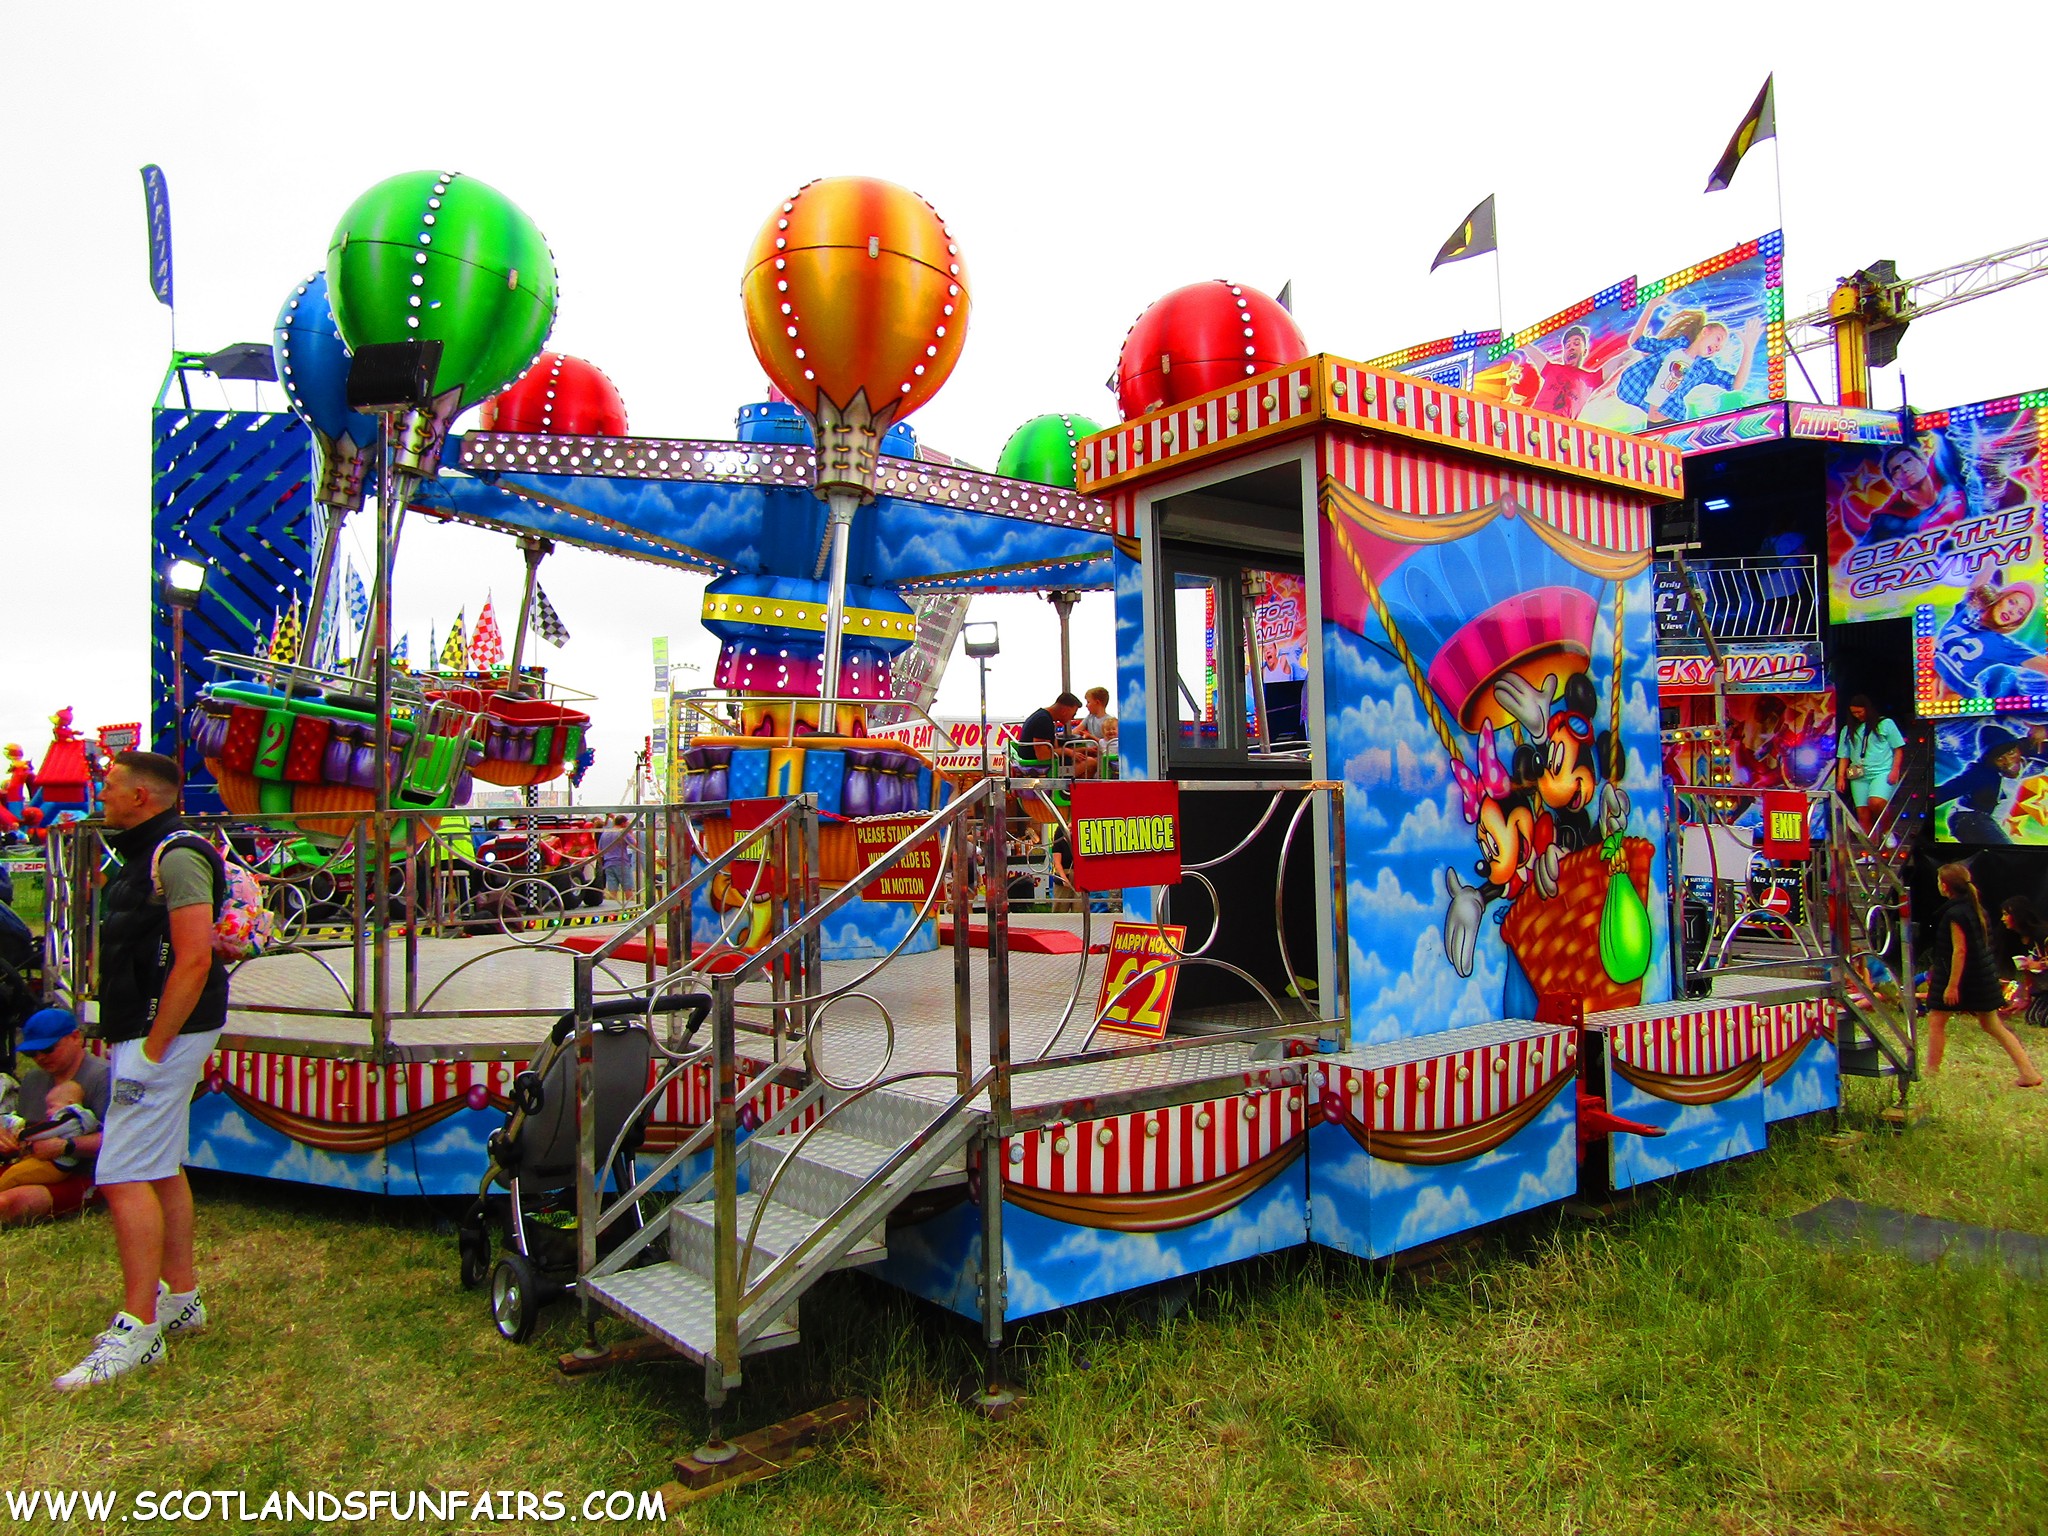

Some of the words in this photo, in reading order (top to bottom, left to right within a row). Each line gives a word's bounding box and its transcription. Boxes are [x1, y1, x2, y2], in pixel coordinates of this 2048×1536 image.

[148, 169, 169, 296] ZIPLINE
[1793, 407, 1841, 439] RIDE
[1838, 418, 1858, 434] OR
[1848, 529, 1948, 575] BEAT
[1952, 507, 2035, 548] THE
[1850, 536, 2032, 598] GRAVITY!
[1659, 581, 1682, 590] Only
[1255, 600, 1295, 622] FOR
[1655, 592, 1688, 613] £1
[1660, 623, 1684, 631] View
[1657, 655, 1715, 684] CKY
[1724, 654, 1816, 683] WALL
[259, 721, 286, 769] 2
[913, 725, 935, 749] EAT
[995, 724, 1023, 747] FO
[935, 755, 982, 768] DONUTS
[778, 759, 792, 797] 1
[857, 826, 886, 844] PLEASE
[1079, 815, 1175, 857] ENTRANCE
[1770, 811, 1802, 842] EXIT
[900, 851, 921, 869] RIDE
[921, 851, 931, 868] IS
[880, 877, 891, 895] IN
[892, 877, 925, 895] MOTION
[1753, 875, 1767, 884] No
[158, 942, 170, 967] BOSS
[1114, 933, 1148, 952] HAPPY
[1149, 935, 1178, 957] HOUR
[1106, 957, 1167, 1028] £2
[169, 1292, 201, 1330] adid
[140, 1334, 163, 1365] adi
